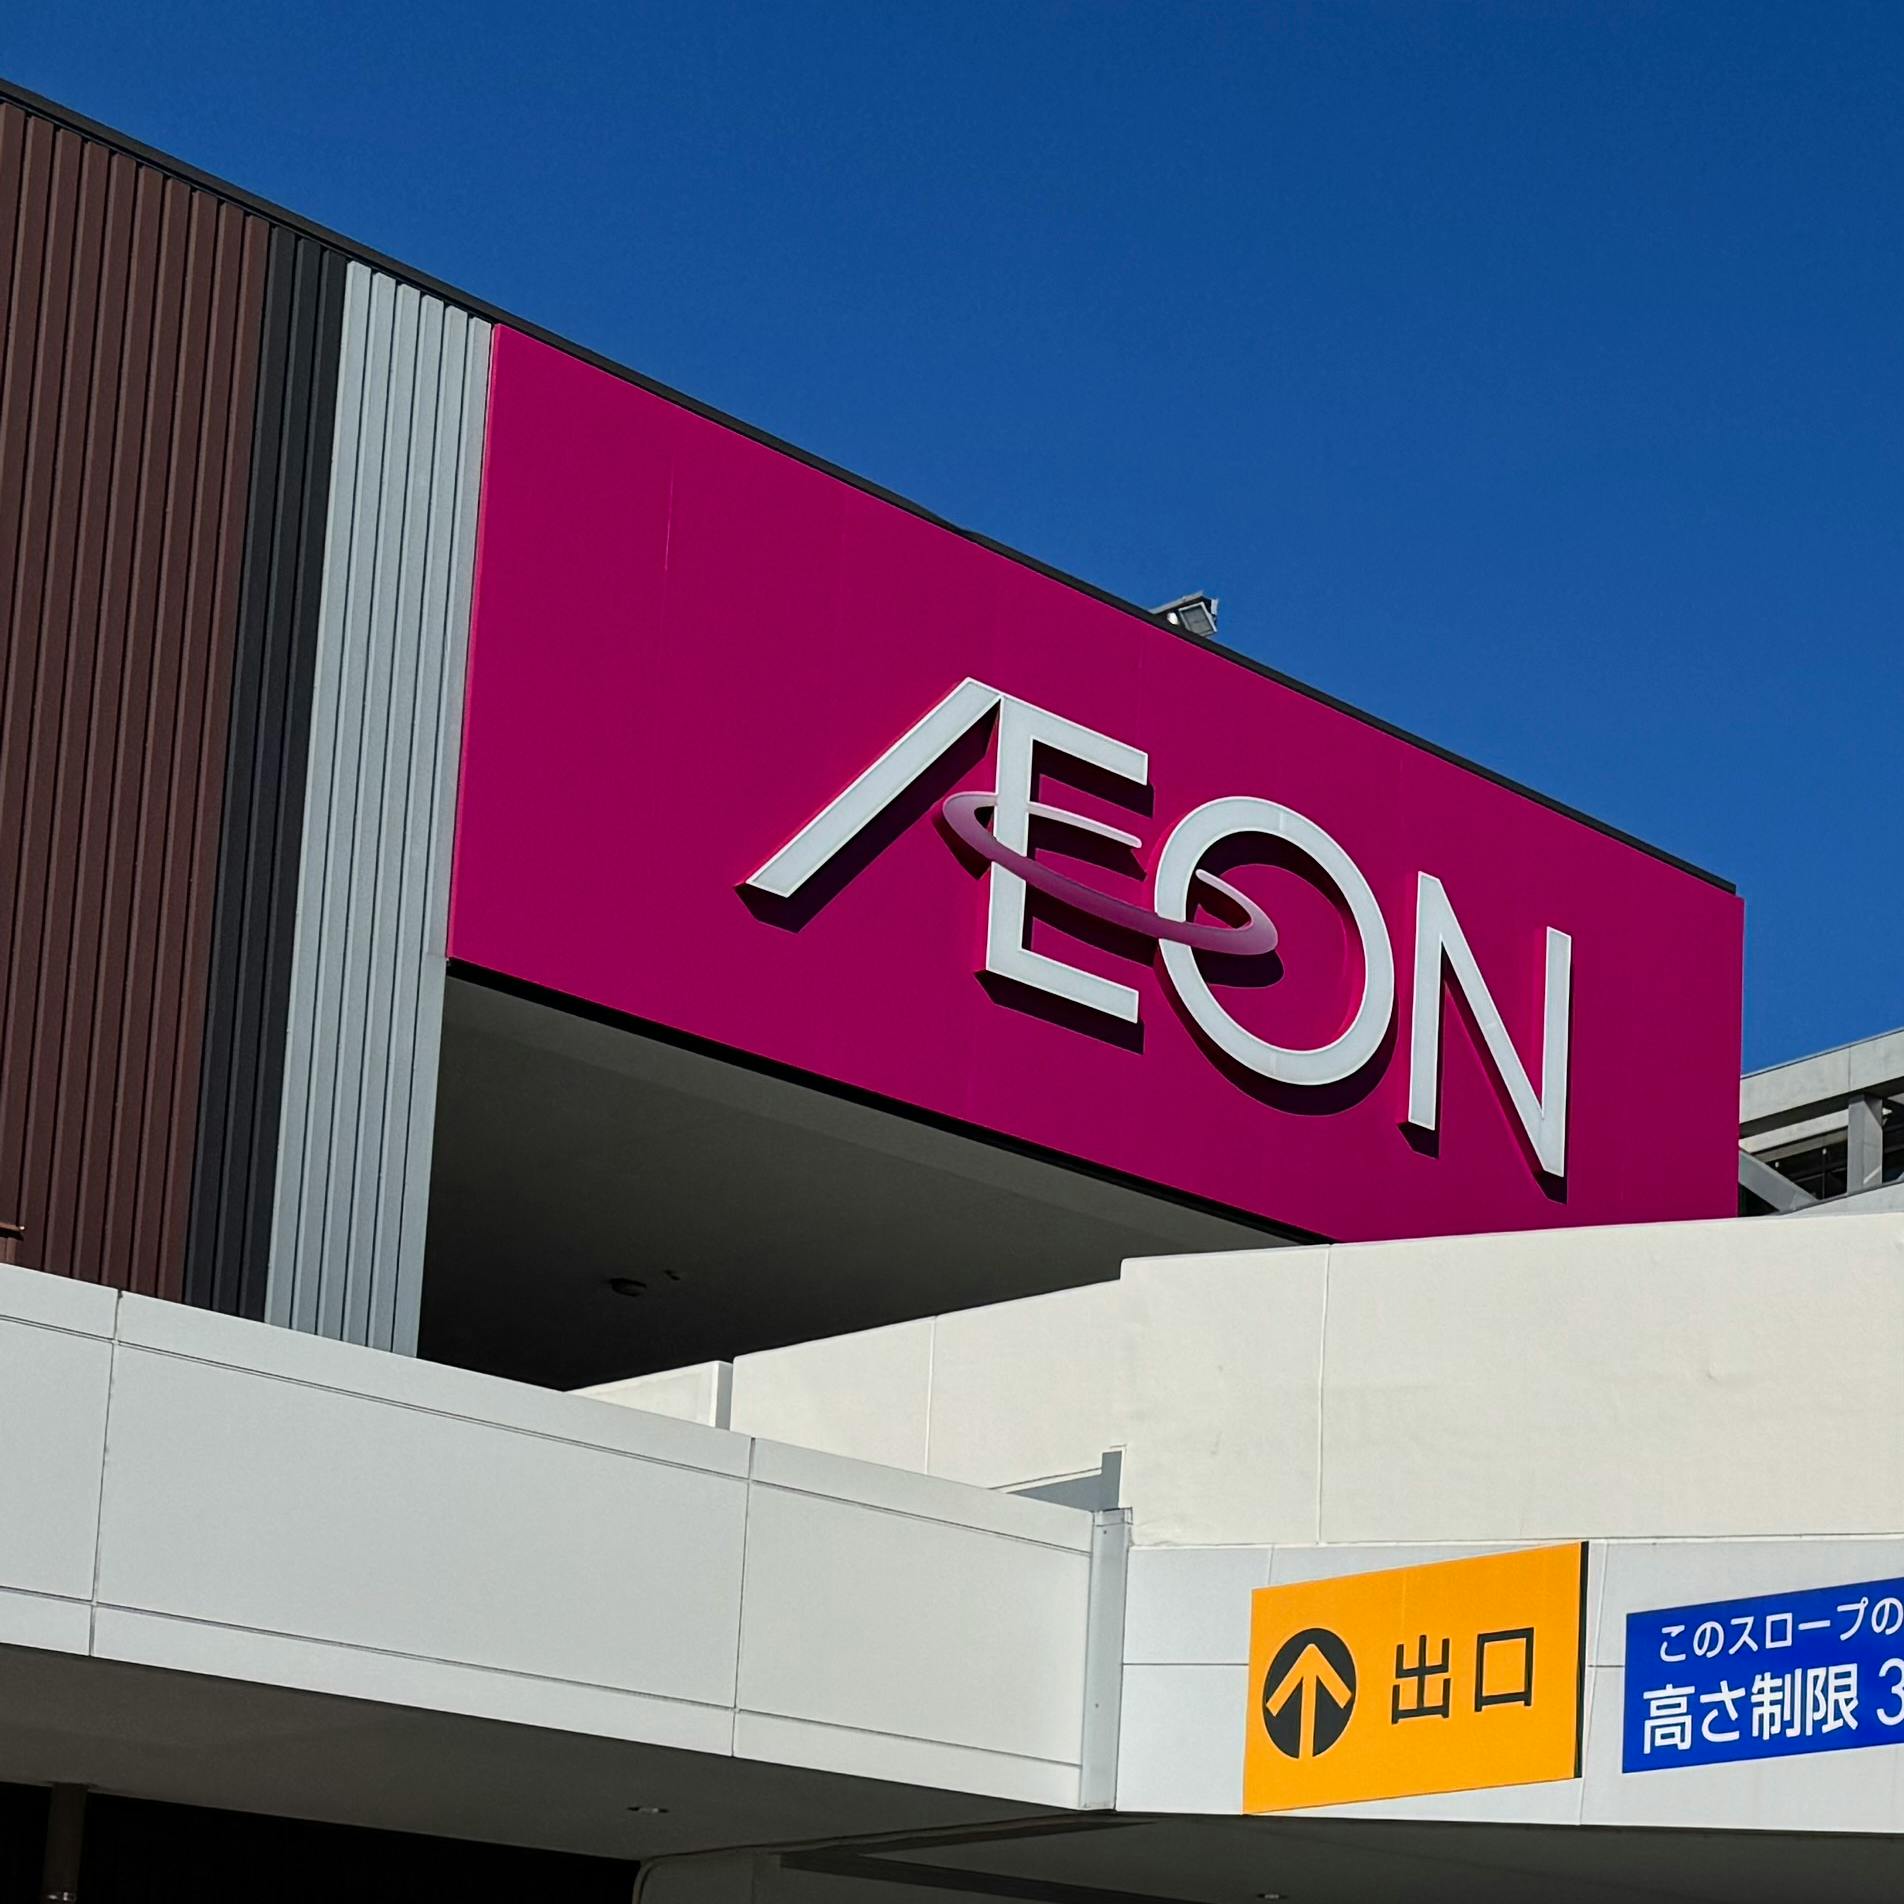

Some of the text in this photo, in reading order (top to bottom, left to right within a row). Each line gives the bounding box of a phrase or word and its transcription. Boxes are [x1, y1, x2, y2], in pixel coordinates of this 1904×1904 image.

[744, 677, 1571, 1178] AEON
[1391, 1626, 1534, 1725] 出口
[1643, 1662, 1859, 1755] 高さ制限
